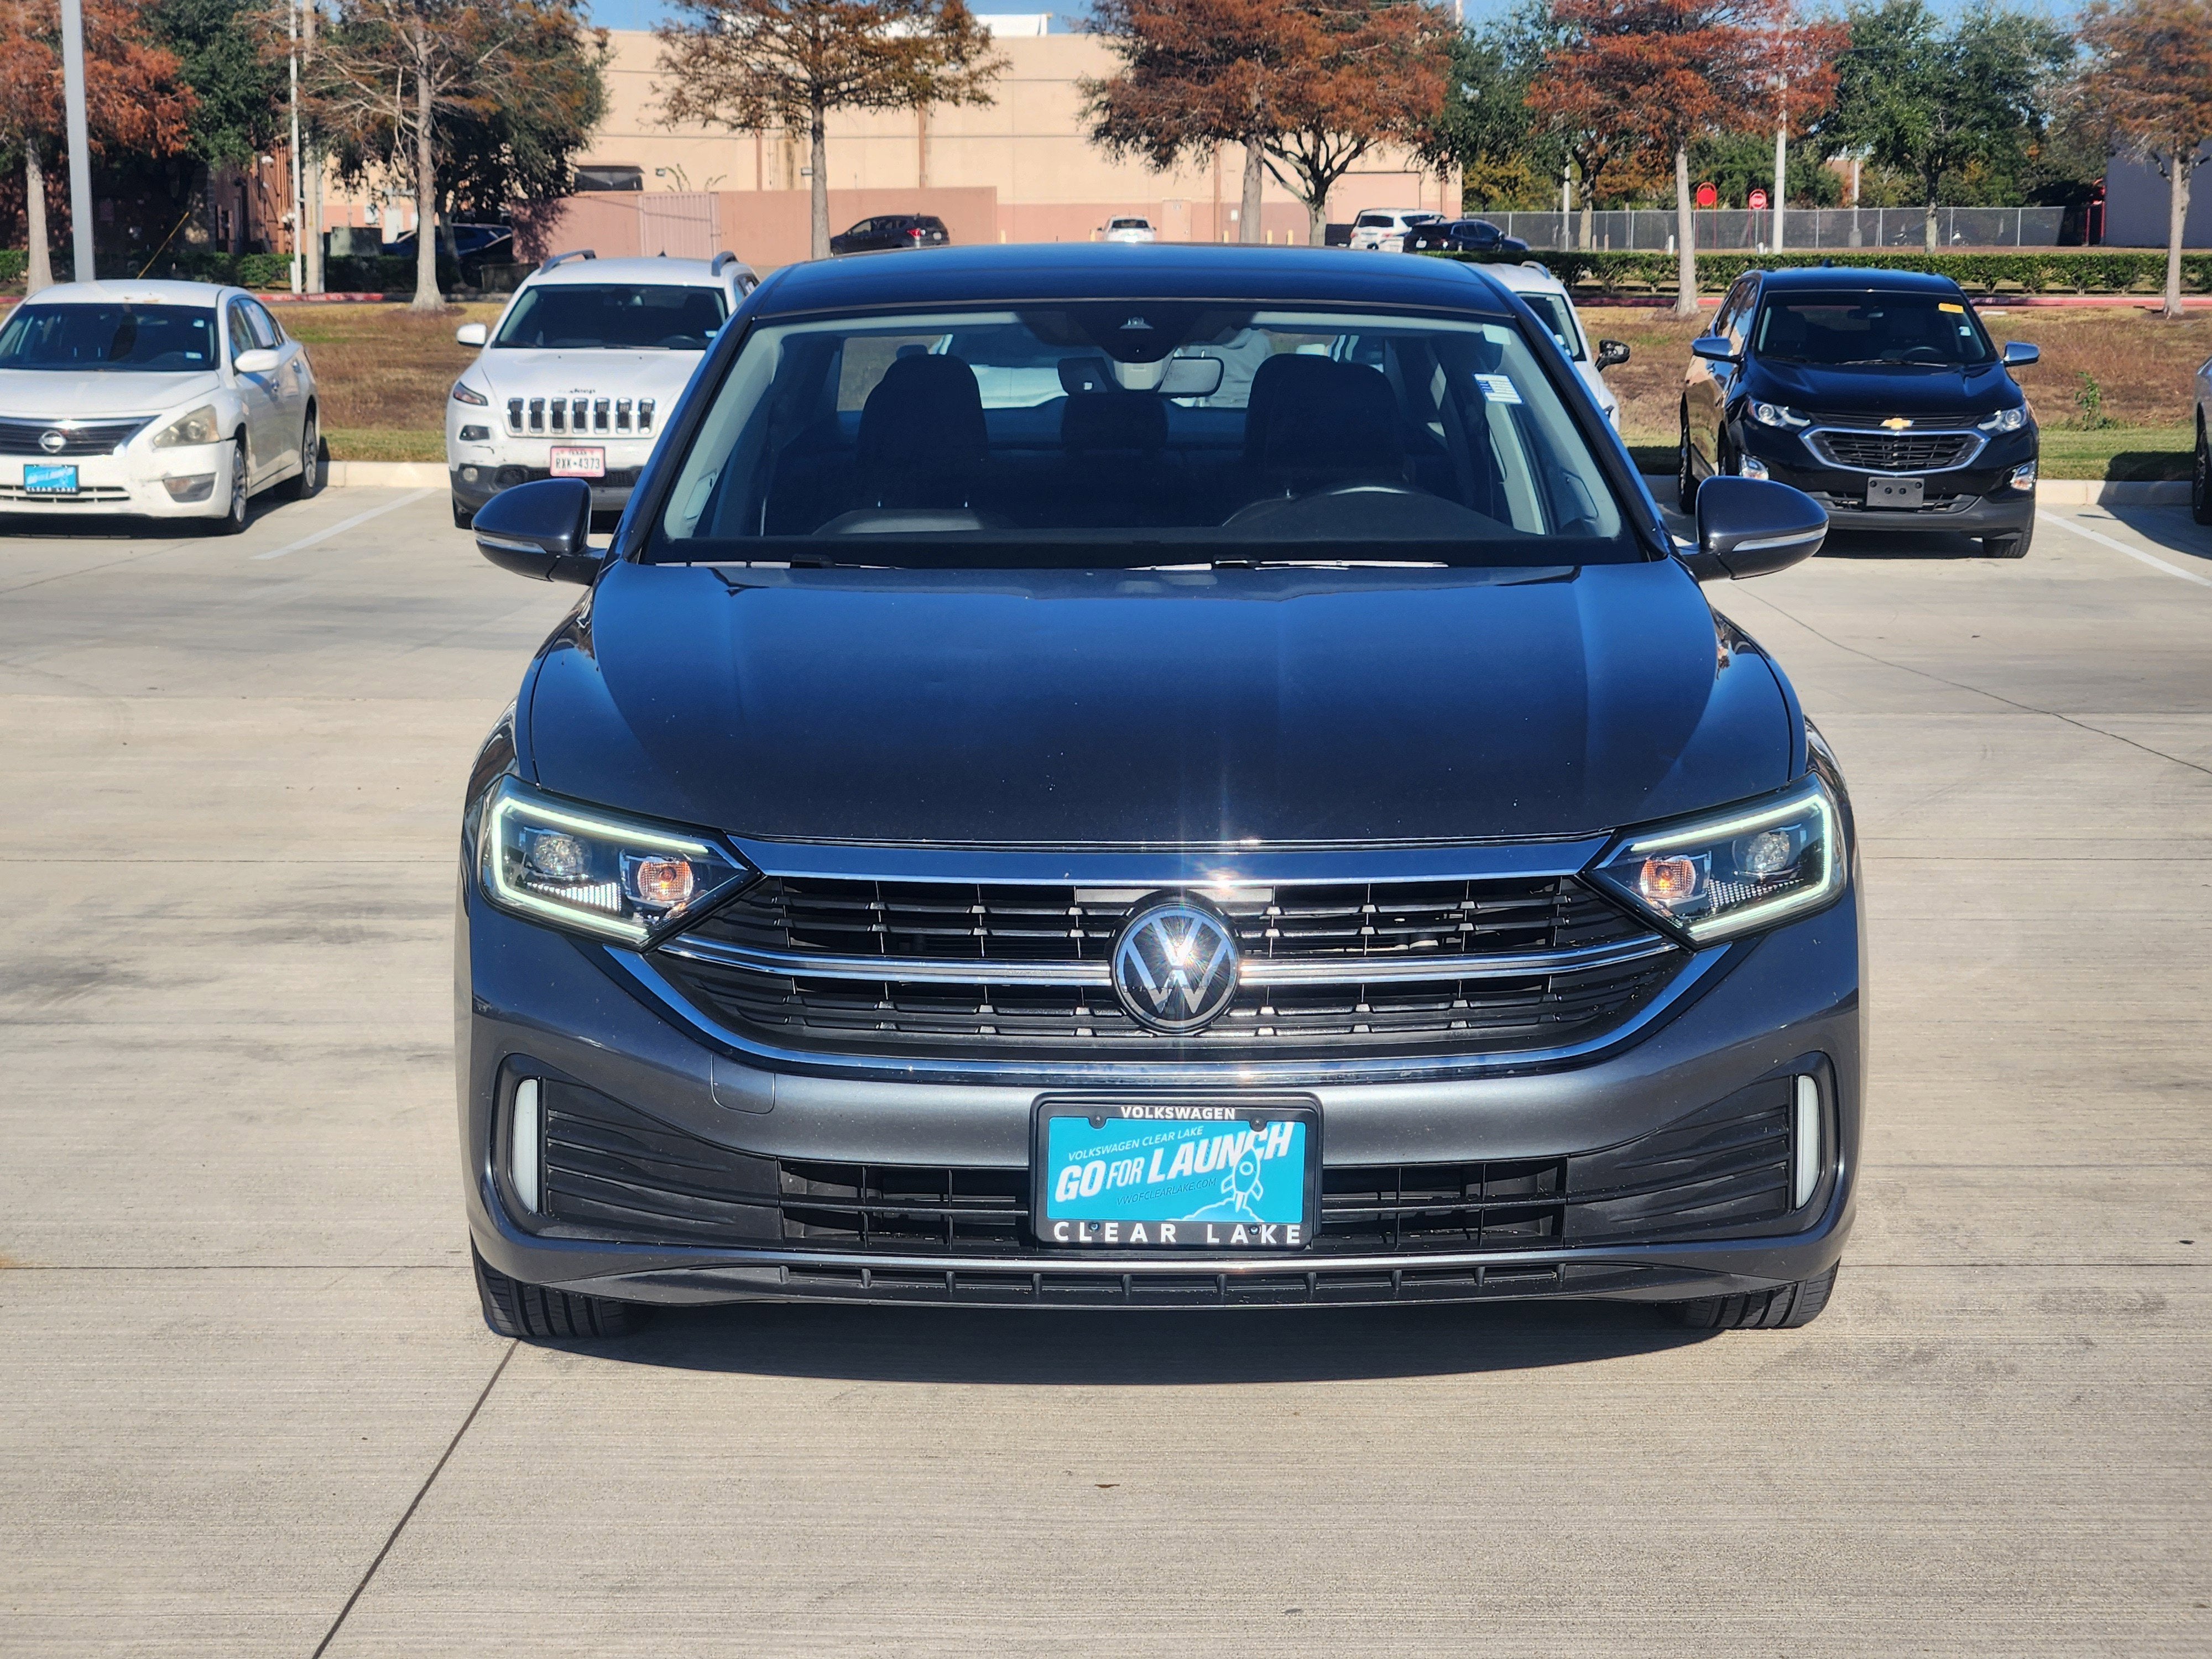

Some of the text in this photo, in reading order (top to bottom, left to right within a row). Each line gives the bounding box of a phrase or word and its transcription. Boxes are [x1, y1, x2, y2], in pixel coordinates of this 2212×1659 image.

[1120, 1107, 1235, 1120] VOLKSWAGEN
[1068, 1125, 1204, 1161] VOLKSWAGEN CLEAR LAKE
[1055, 1121, 1295, 1202] GO FOR LAUNCH
[1117, 1177, 1217, 1206] VWOFCLEARLAKE.COM
[1053, 1221, 1301, 1244] CLEAR LAKE
